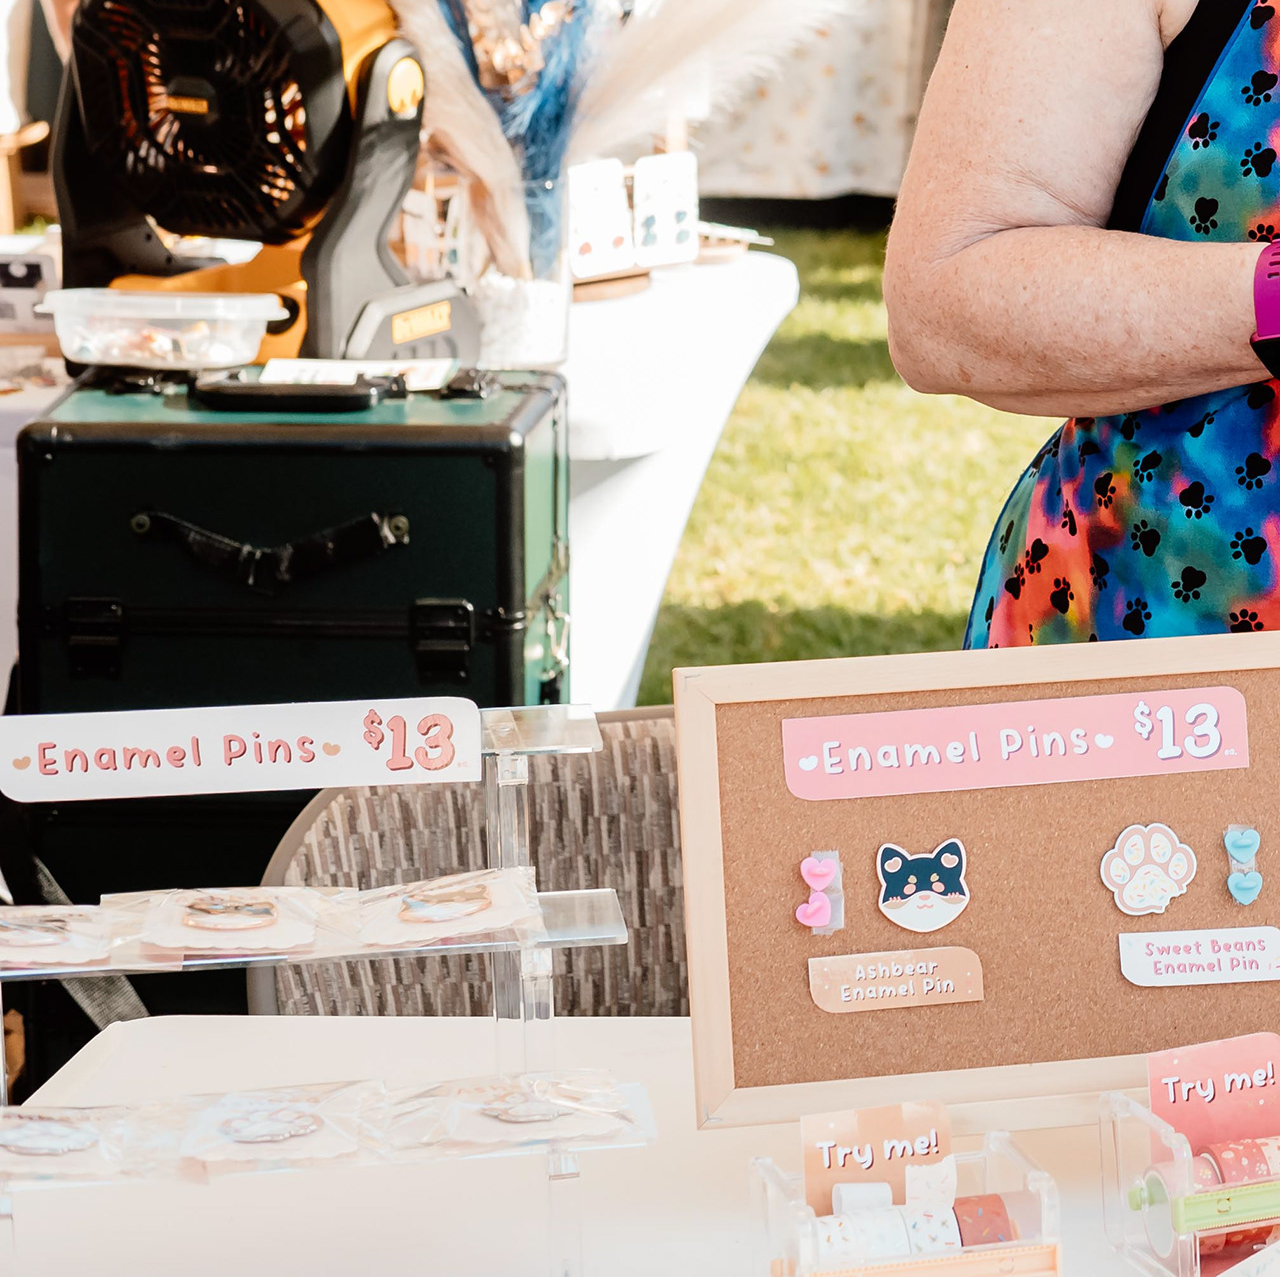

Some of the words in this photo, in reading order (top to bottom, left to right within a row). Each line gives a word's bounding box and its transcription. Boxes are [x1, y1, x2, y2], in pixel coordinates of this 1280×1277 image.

[37, 735, 203, 776] Enamel
[223, 731, 316, 766] Pins
[362, 708, 457, 773] $13
[822, 730, 980, 775] Enamel
[1000, 725, 1090, 762] Pins
[1132, 700, 1224, 762] $13
[1144, 940, 1202, 957] Sweet
[1210, 938, 1267, 955] Beans
[855, 959, 938, 982] Ashbear
[1153, 958, 1222, 976] Enamel
[1230, 956, 1259, 972] Pin
[840, 979, 916, 1003] Enamel
[923, 976, 956, 995] Pin
[1161, 1076, 1216, 1105] Try
[1224, 1061, 1276, 1093] me!
[815, 1139, 875, 1171] Try
[883, 1128, 940, 1160] me!
